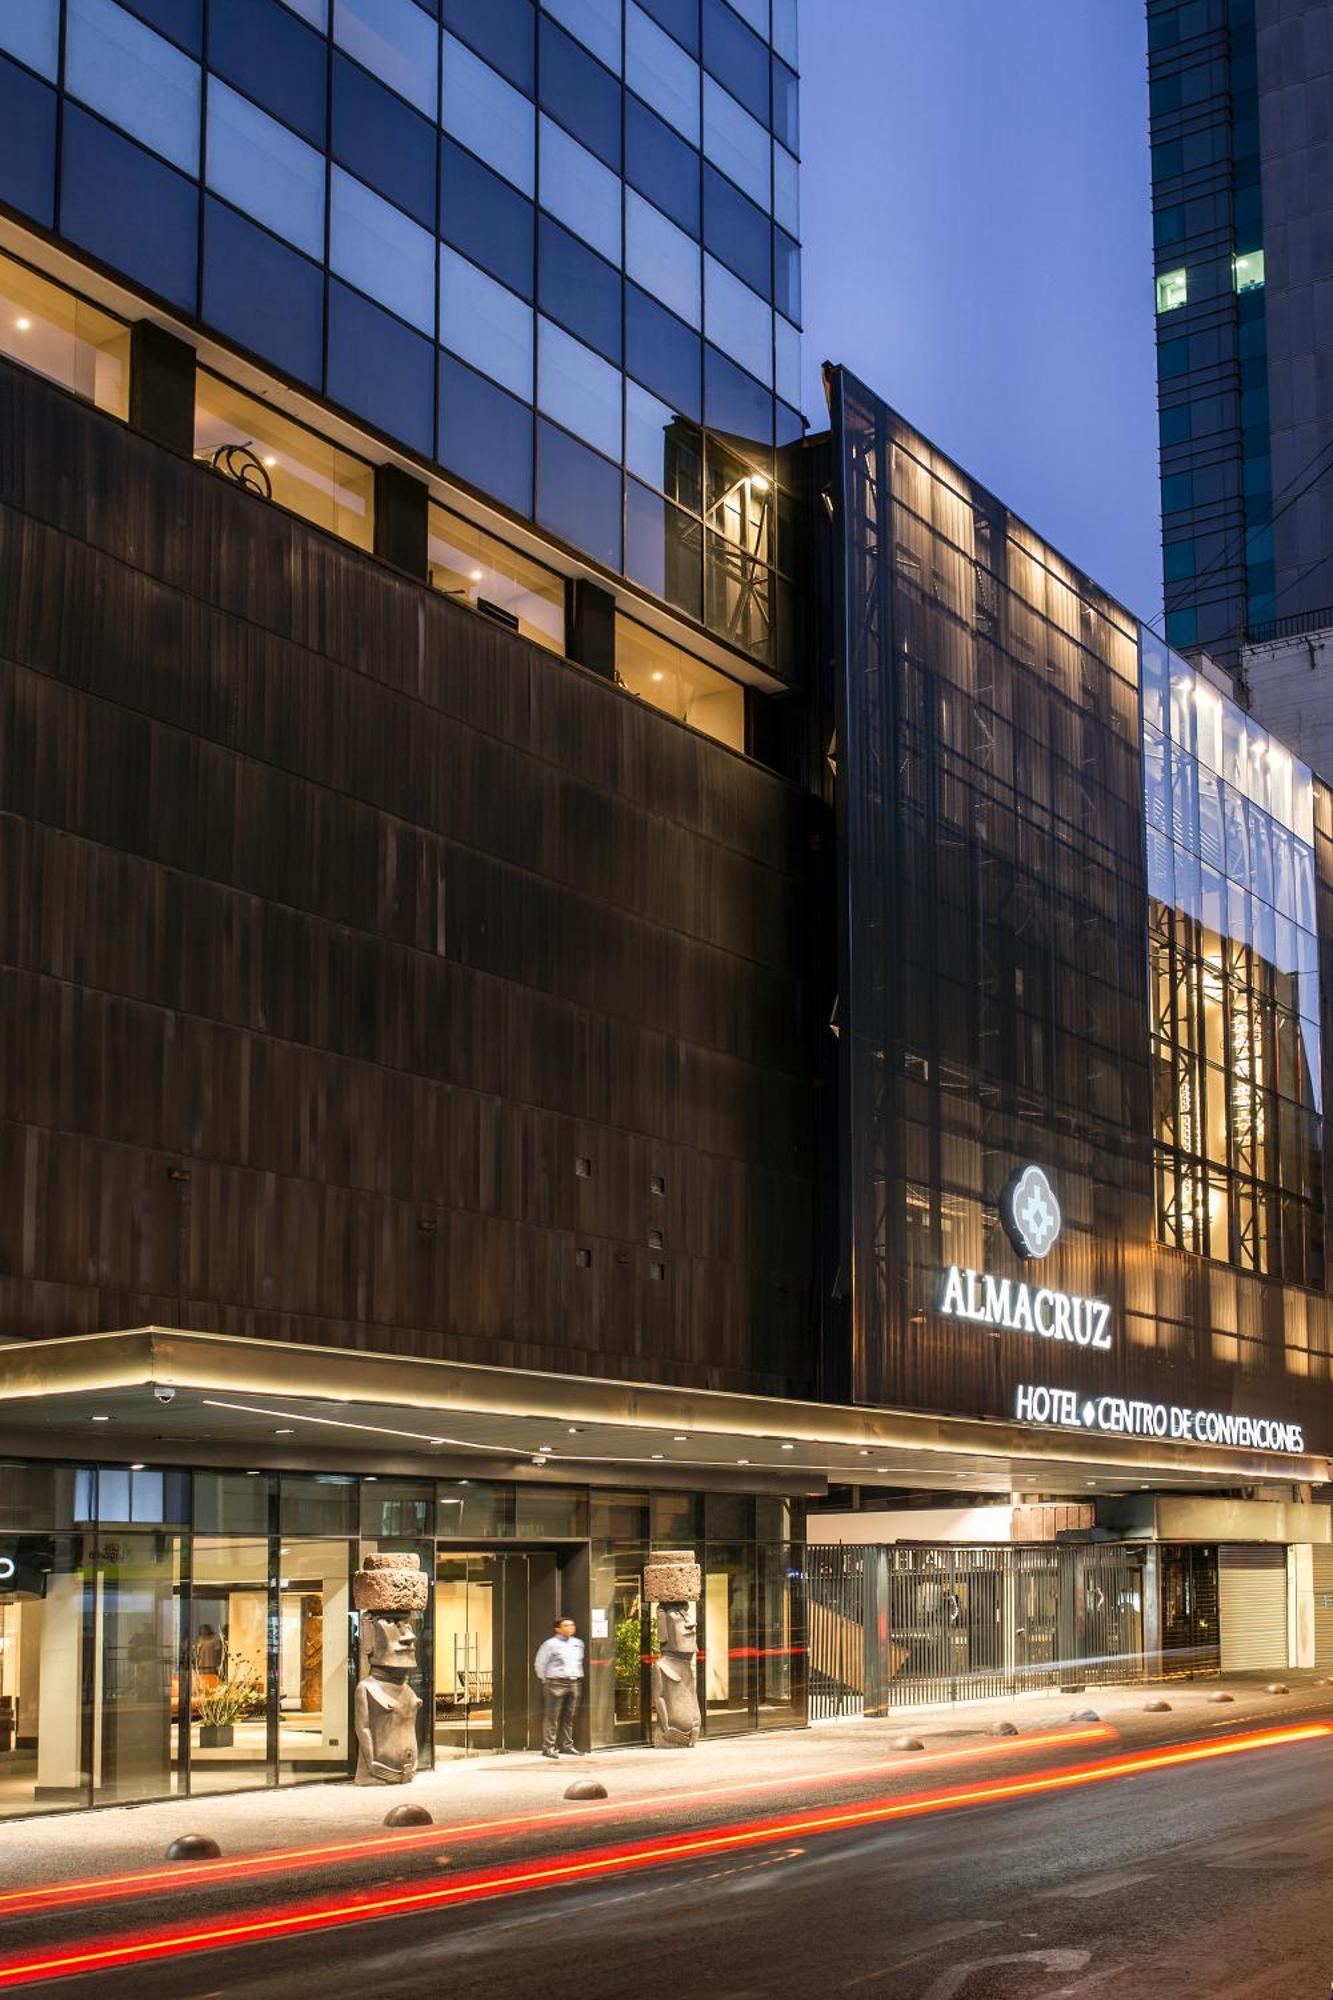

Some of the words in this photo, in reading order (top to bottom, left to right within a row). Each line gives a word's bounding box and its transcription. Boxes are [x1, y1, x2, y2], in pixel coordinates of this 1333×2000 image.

[942, 1265, 1112, 1349] ALMACRUZ
[1016, 1384, 1081, 1426] HOTEL
[1098, 1396, 1168, 1437] CENTRO
[1171, 1407, 1192, 1439] DE
[1195, 1410, 1304, 1453] CONVENCIONES
